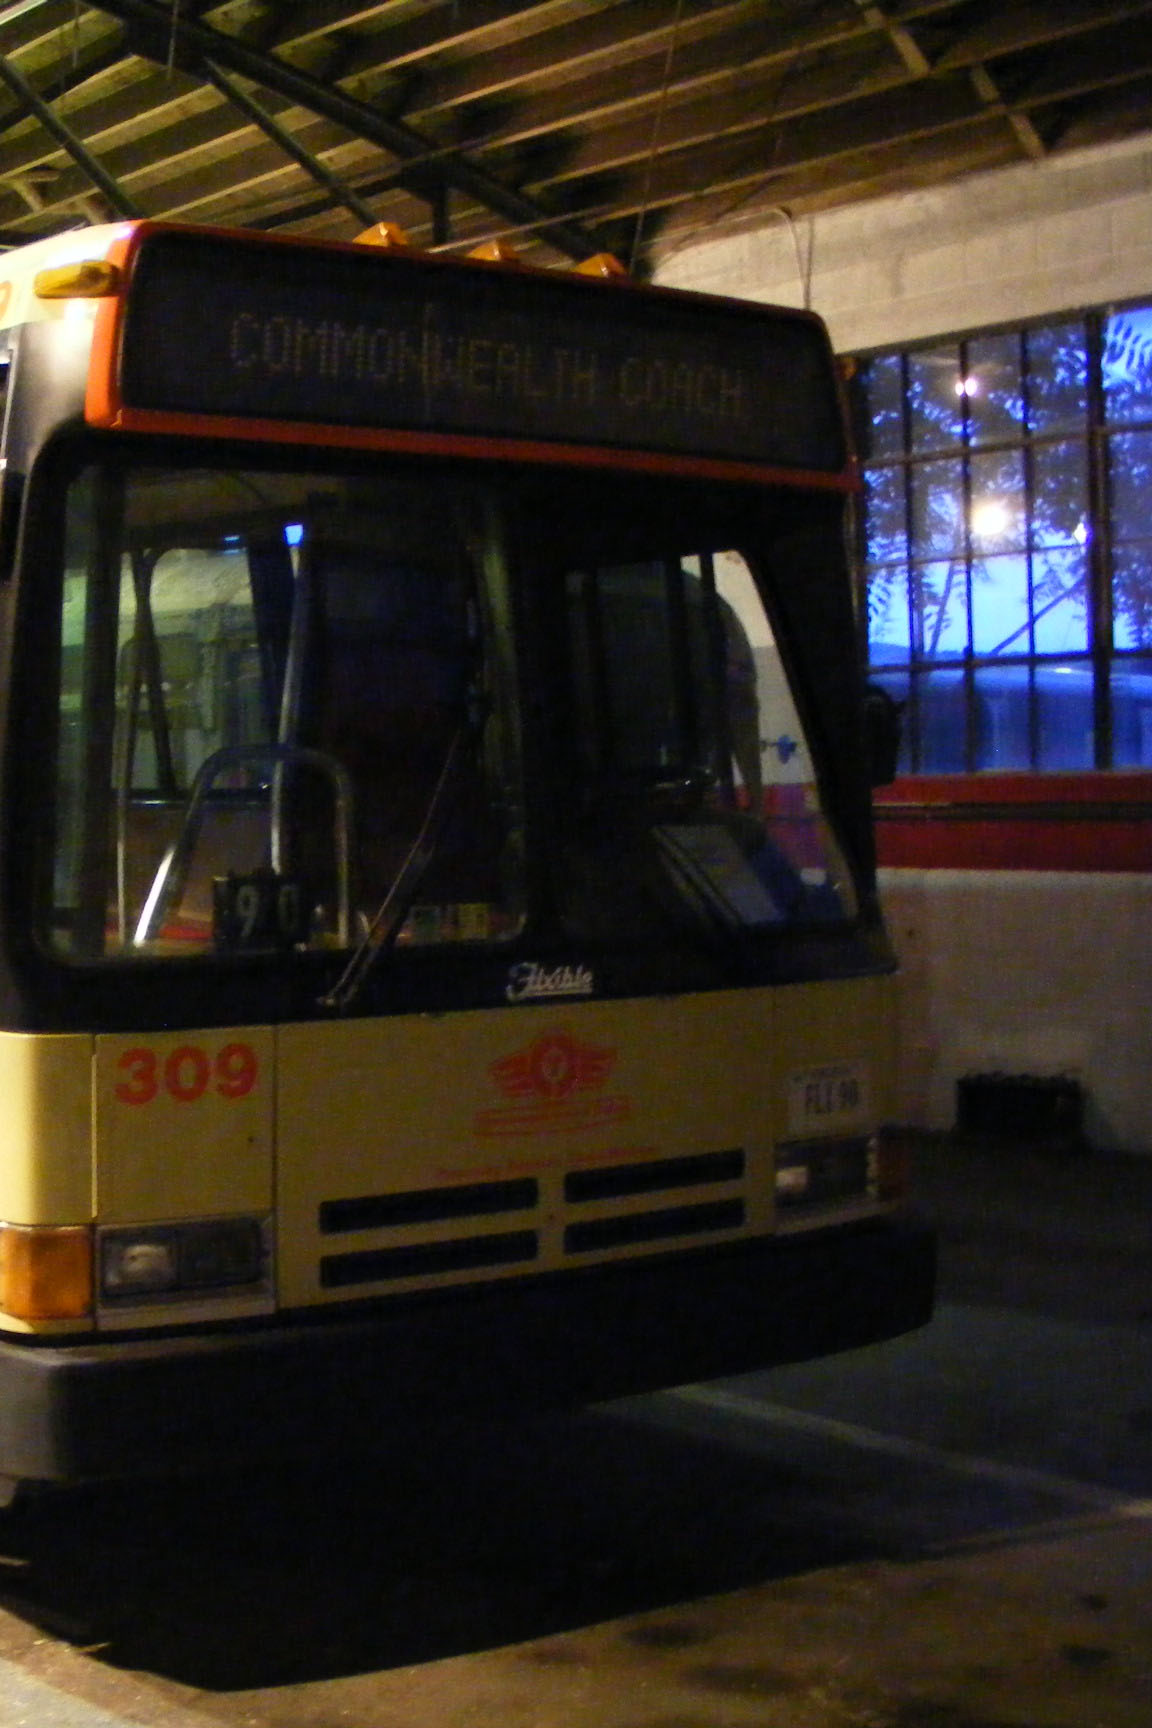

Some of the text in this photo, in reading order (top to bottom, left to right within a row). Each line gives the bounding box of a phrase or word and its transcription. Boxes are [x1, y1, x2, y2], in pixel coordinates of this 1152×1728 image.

[229, 310, 745, 417] COMMONWEALTH COACH
[114, 1042, 259, 1107] 309
